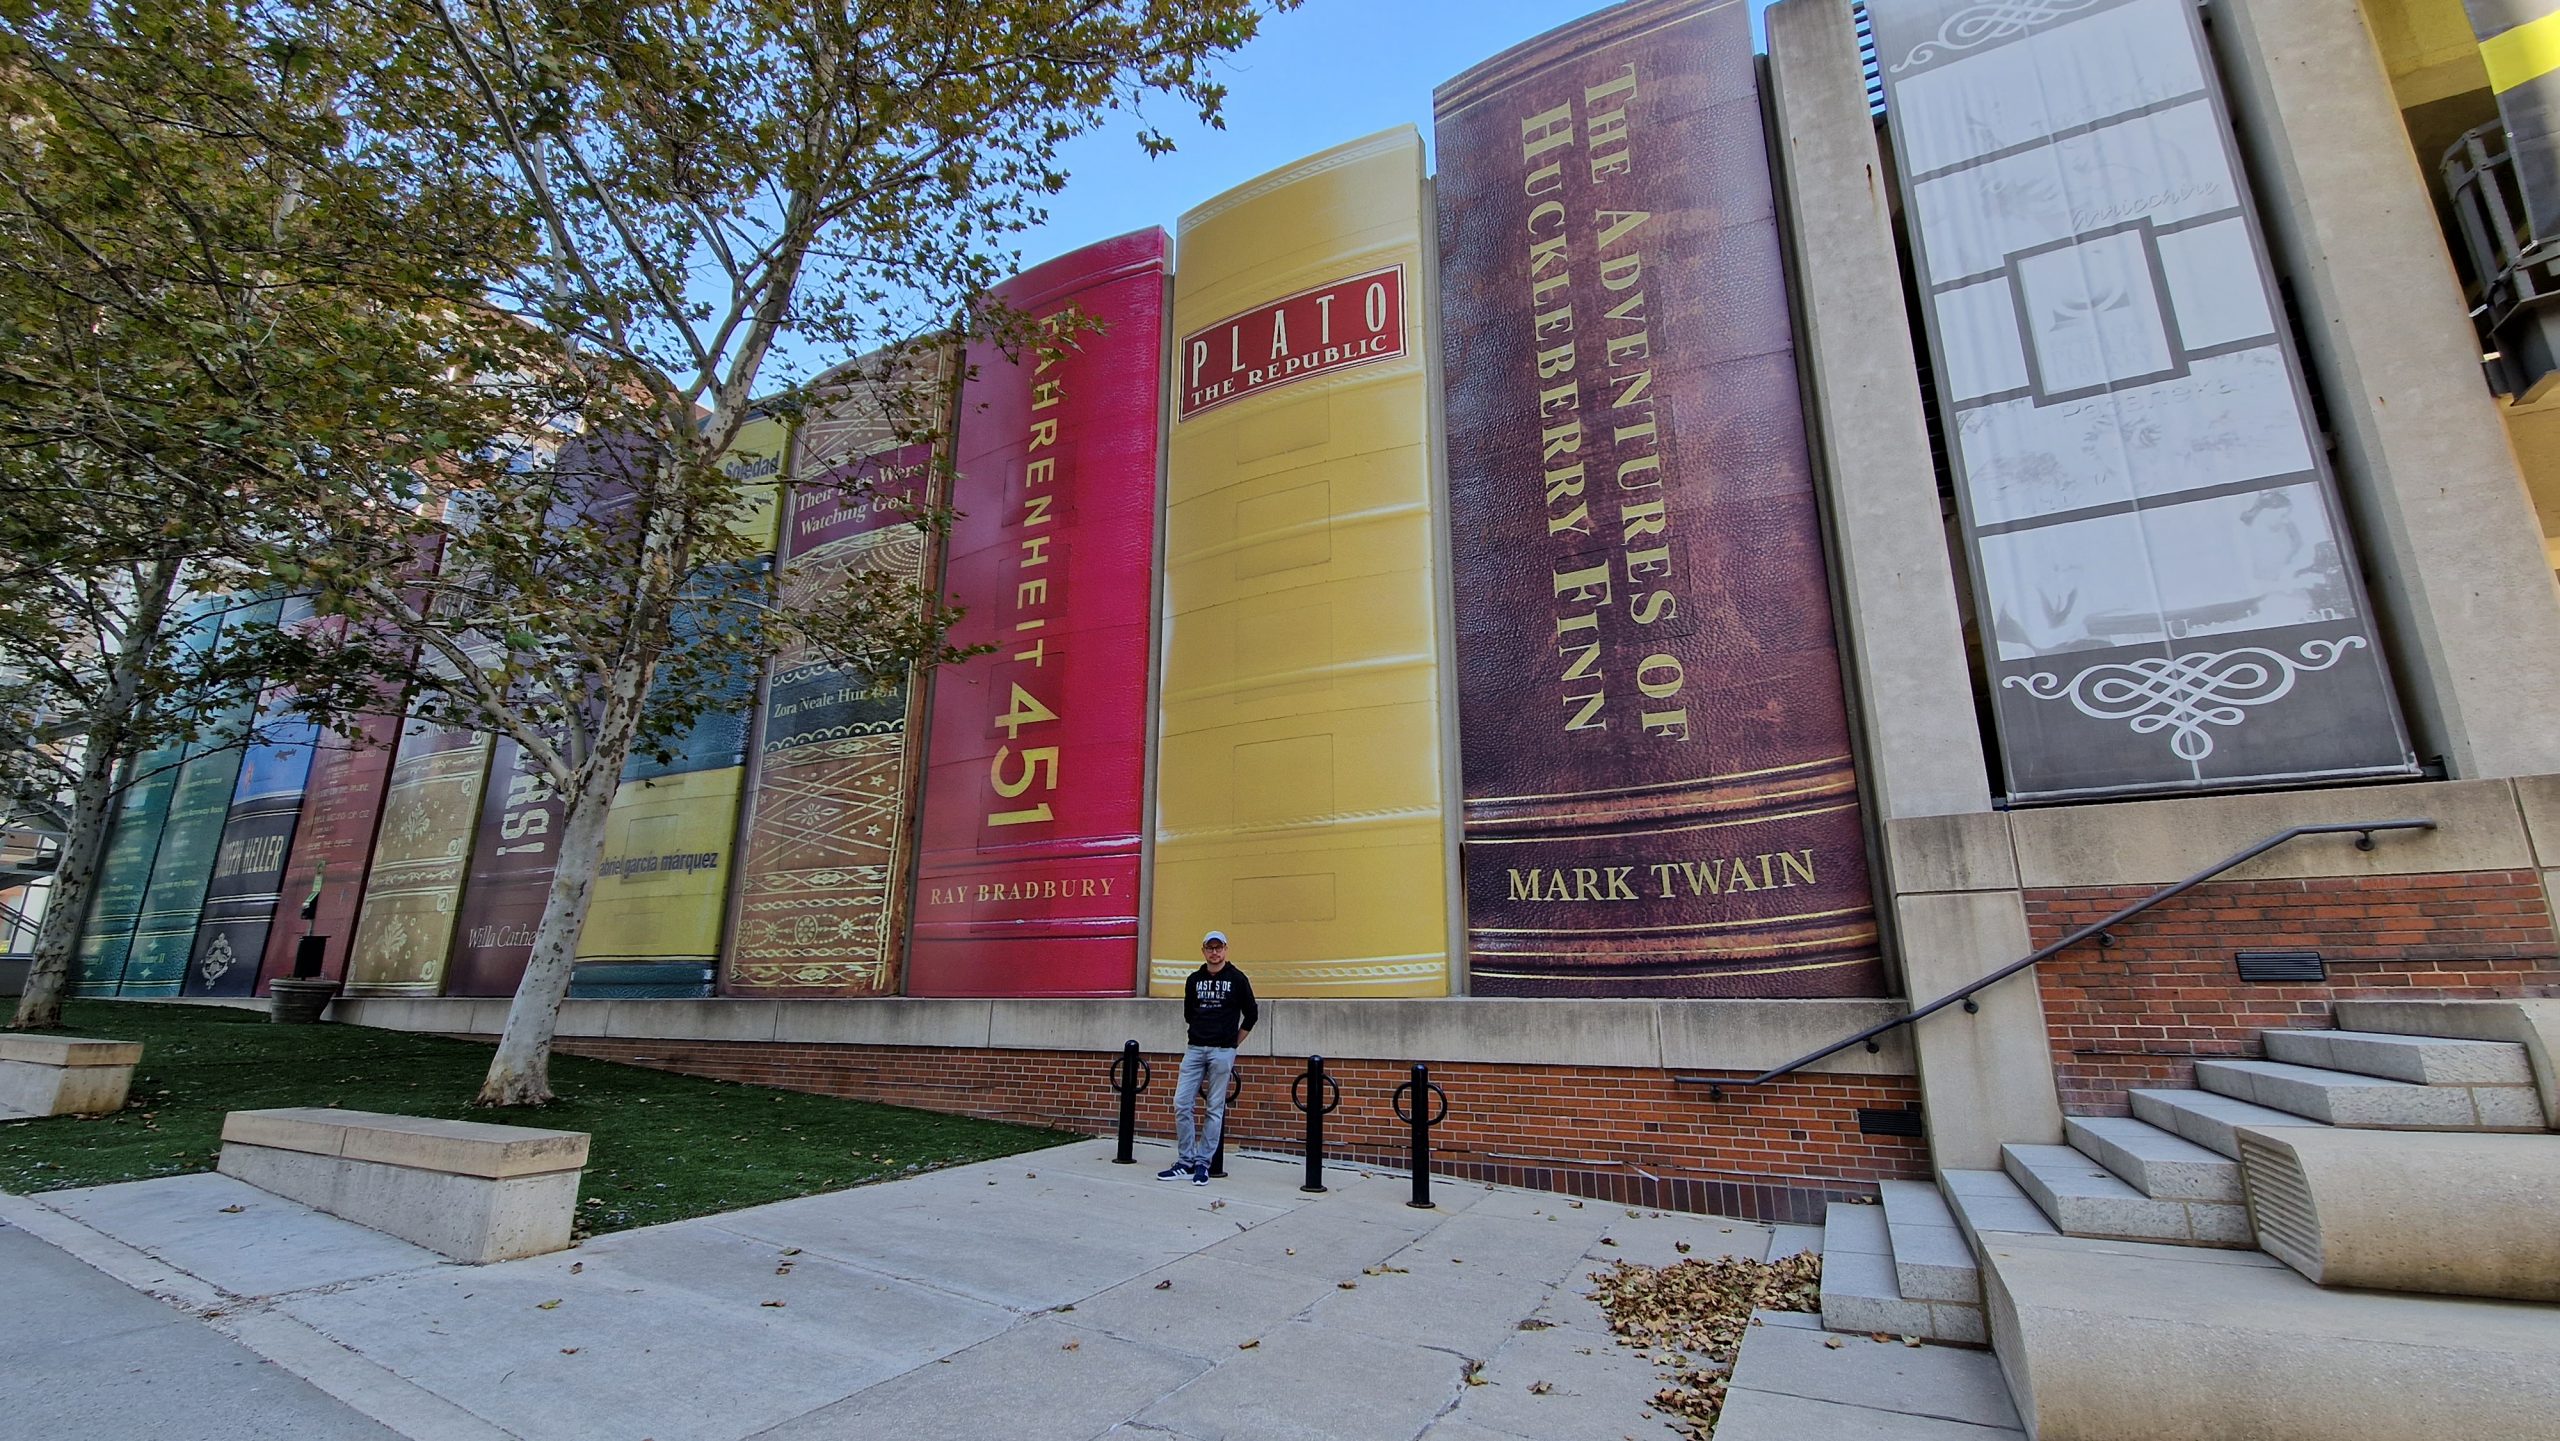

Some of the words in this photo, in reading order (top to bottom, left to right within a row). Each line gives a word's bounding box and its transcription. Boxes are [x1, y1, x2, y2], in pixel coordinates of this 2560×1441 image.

[1585, 62, 1638, 184] THE
[1192, 282, 1387, 389] PLATO
[1521, 97, 1590, 537] HUCKLEBERRY
[1191, 377, 1236, 407] THE
[1247, 334, 1388, 387] REPUBLIC
[1595, 208, 1679, 625] ADVENTURES
[798, 487, 834, 513] Their
[801, 503, 868, 537] Watching
[1553, 558, 1612, 732] FINN
[774, 703, 798, 719] Zora
[800, 692, 834, 712] Neale
[1637, 653, 1690, 742] OF
[988, 681, 1061, 827] 451
[242, 835, 284, 875] HELLER
[599, 854, 624, 877] abriel
[1507, 866, 1639, 901] MARK
[1650, 849, 1817, 899] TWAIN
[930, 885, 968, 905] RAY
[978, 877, 1116, 902] BRADBURY
[468, 925, 496, 948] Willa
[497, 923, 537, 948] Cathe
